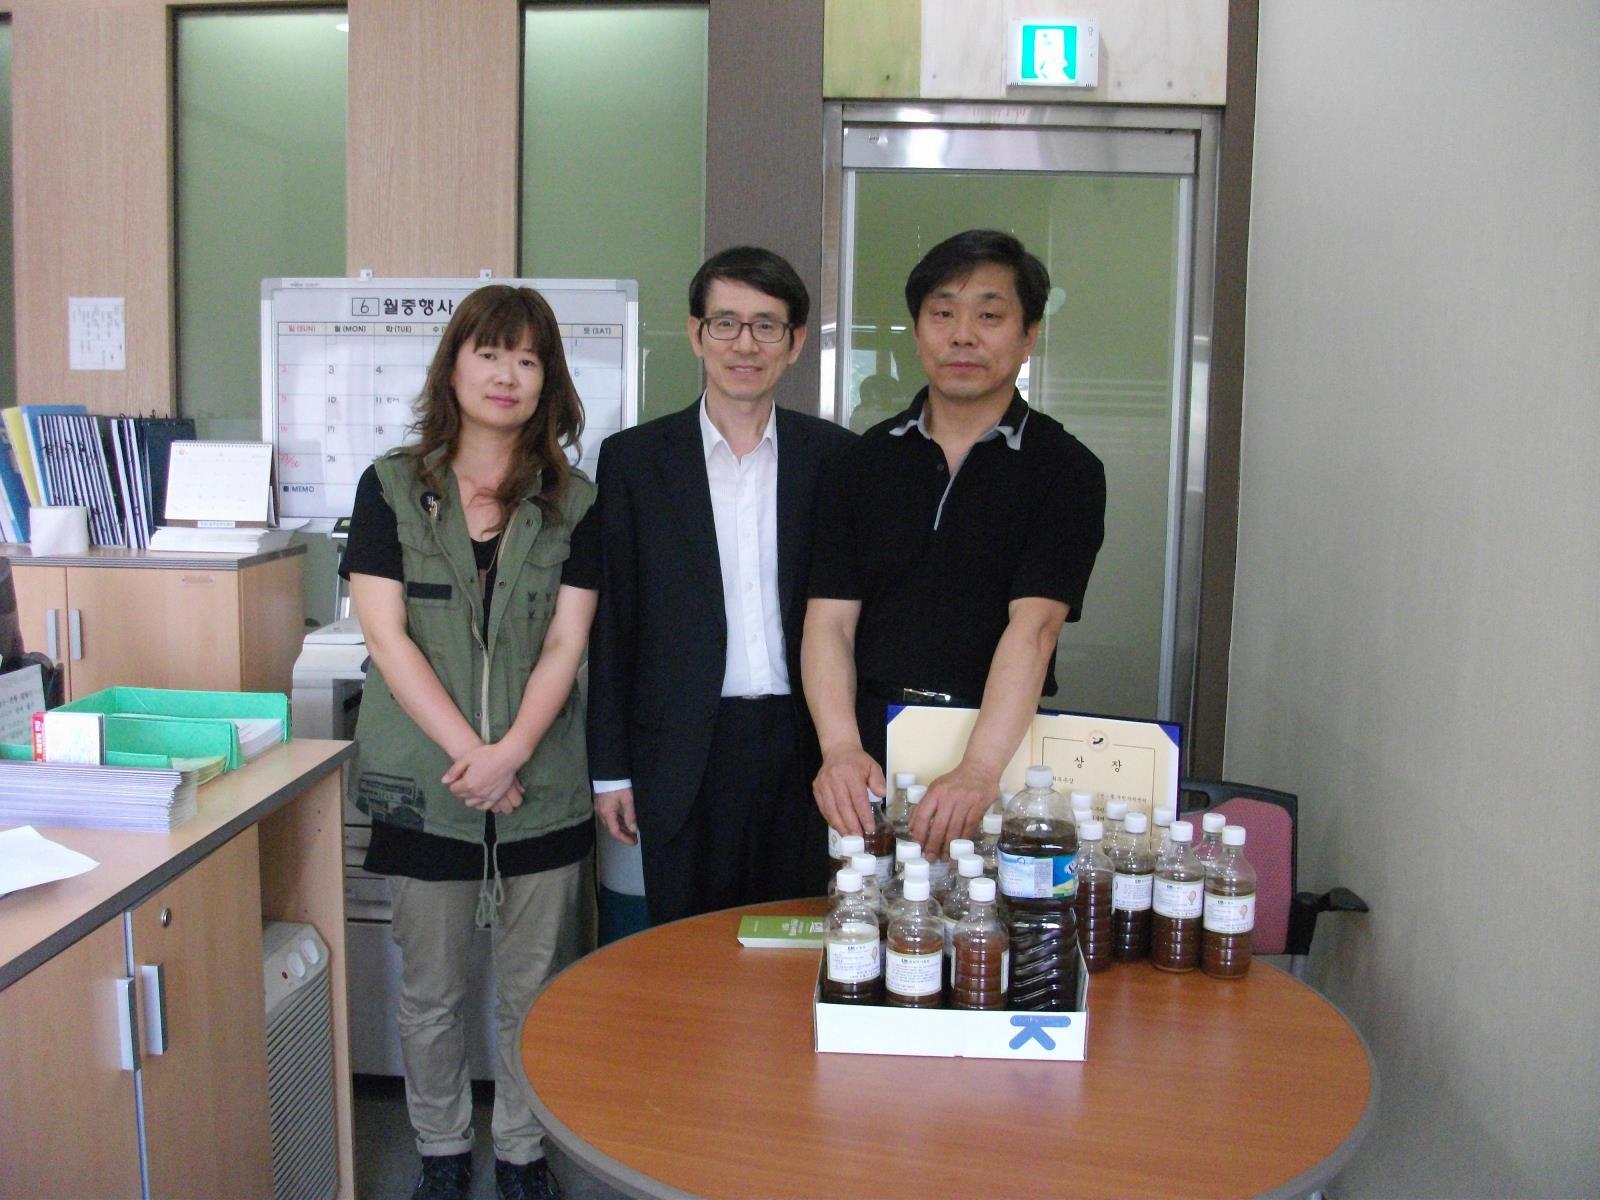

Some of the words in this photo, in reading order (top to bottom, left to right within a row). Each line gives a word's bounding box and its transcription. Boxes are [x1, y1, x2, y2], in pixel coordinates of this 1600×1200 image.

[360, 299, 370, 314] 6
[342, 325, 367, 333] (MON)
[394, 325, 412, 333] (TUE)
[328, 365, 335, 374] 3
[375, 366, 383, 374] 4
[375, 426, 384, 435] 18
[291, 485, 315, 493] MEMO
